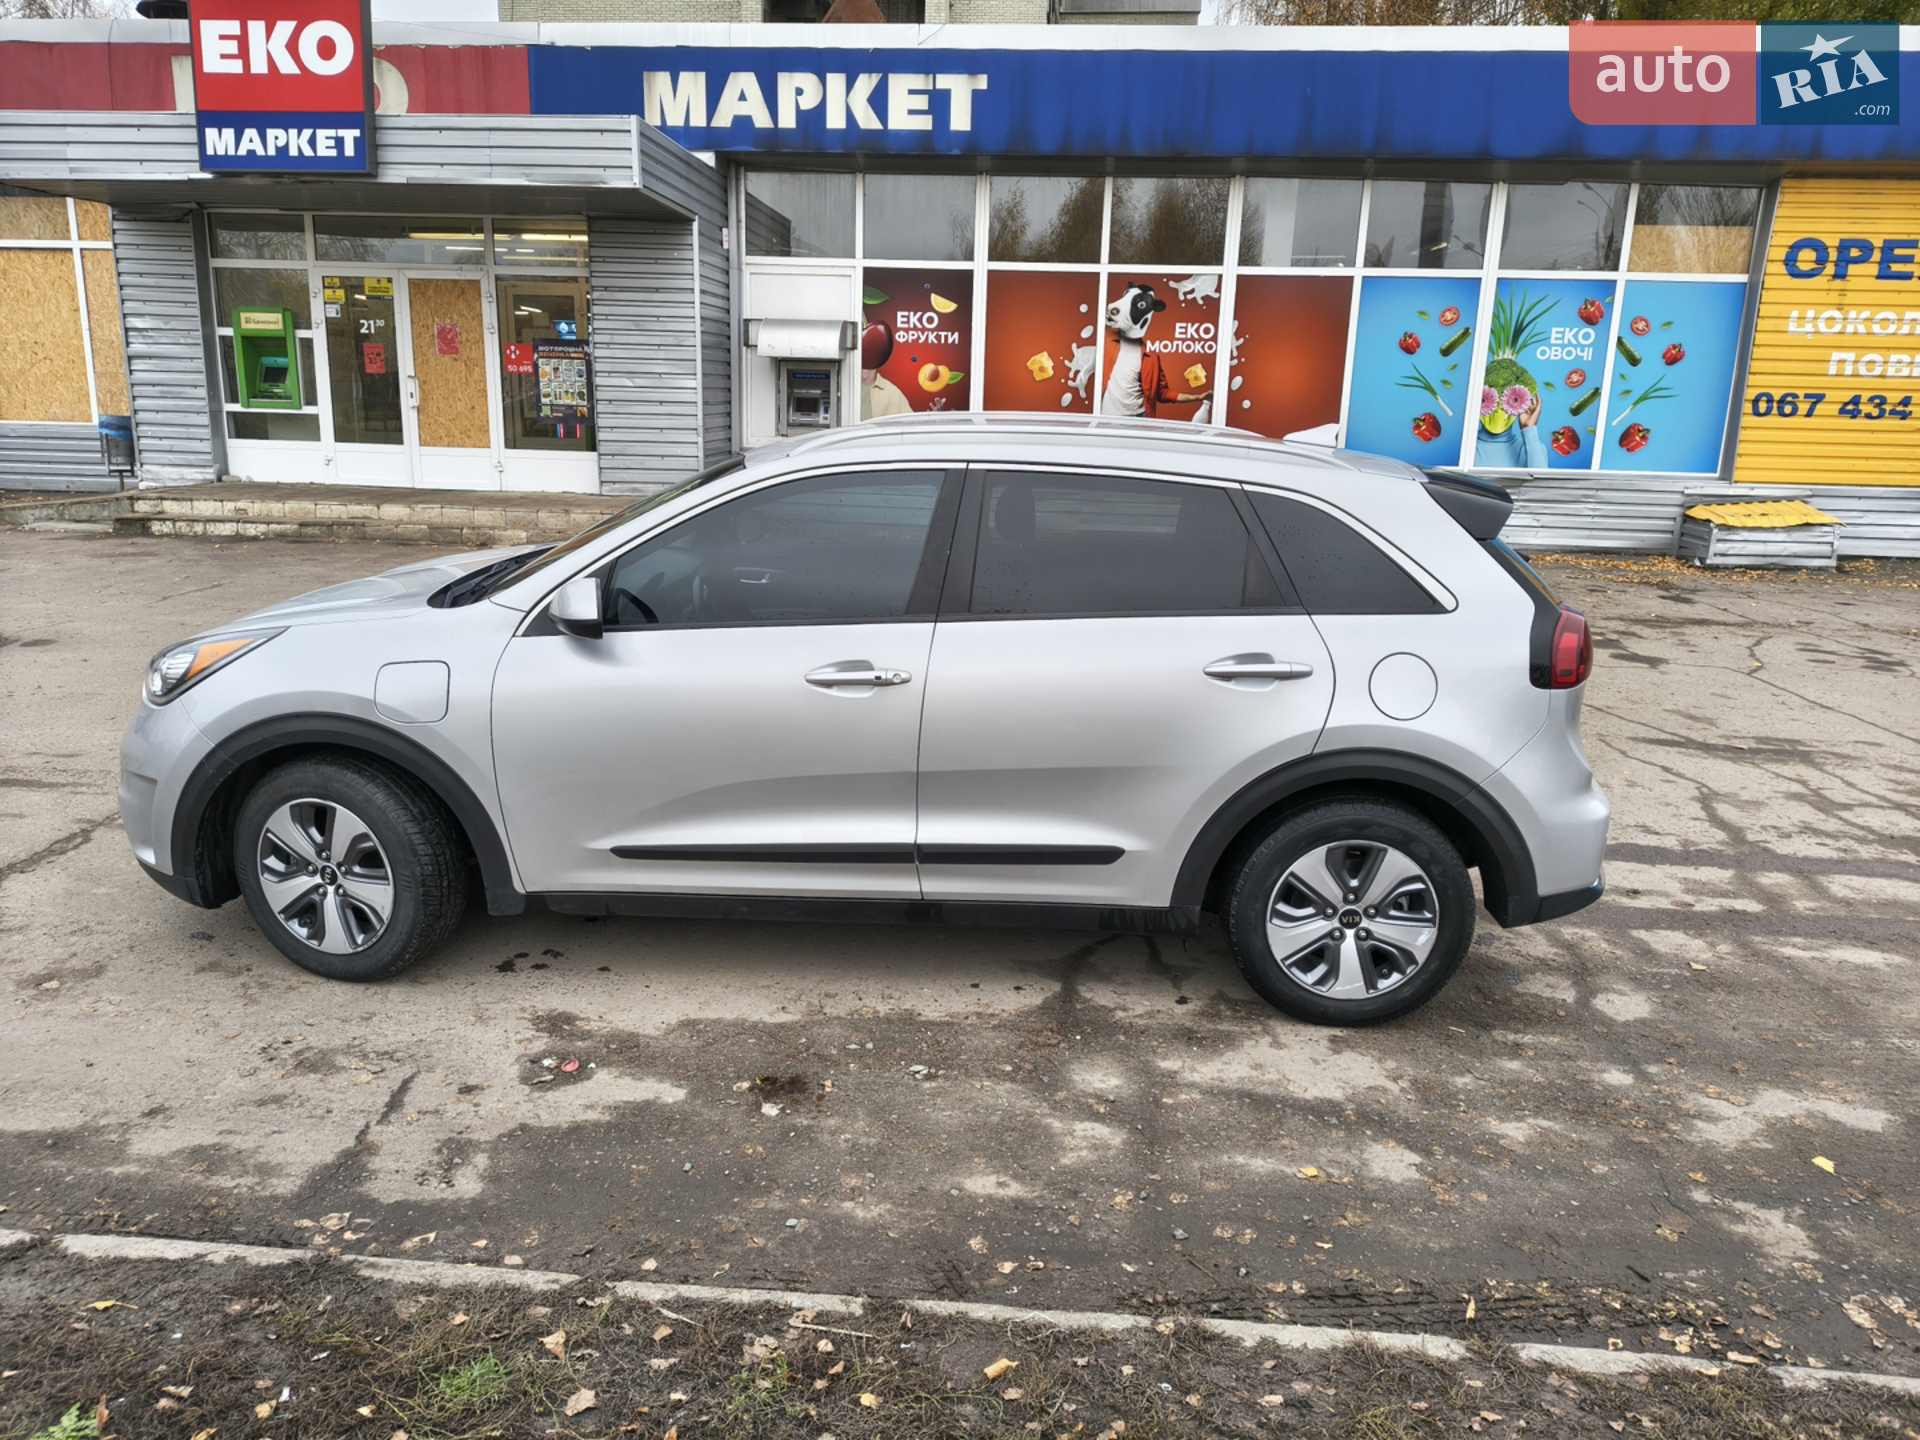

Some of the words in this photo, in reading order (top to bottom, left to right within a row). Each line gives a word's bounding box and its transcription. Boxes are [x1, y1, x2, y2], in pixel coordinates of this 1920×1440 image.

[200, 19, 355, 76] ЕКО
[643, 71, 988, 131] МАРКЕТ
[205, 128, 361, 157] МАРКЕТ
[1783, 236, 1920, 281] ОРЕ
[896, 311, 939, 329] ЕКО
[895, 330, 959, 344] ФРУКТИ
[1174, 322, 1216, 339] ЕКО
[1550, 327, 1596, 345] ЕКО
[1146, 340, 1217, 354] МОЛОКО
[1536, 346, 1593, 361] ОВОЧІ
[1751, 392, 1826, 418] 067
[1838, 394, 1913, 420] 434
